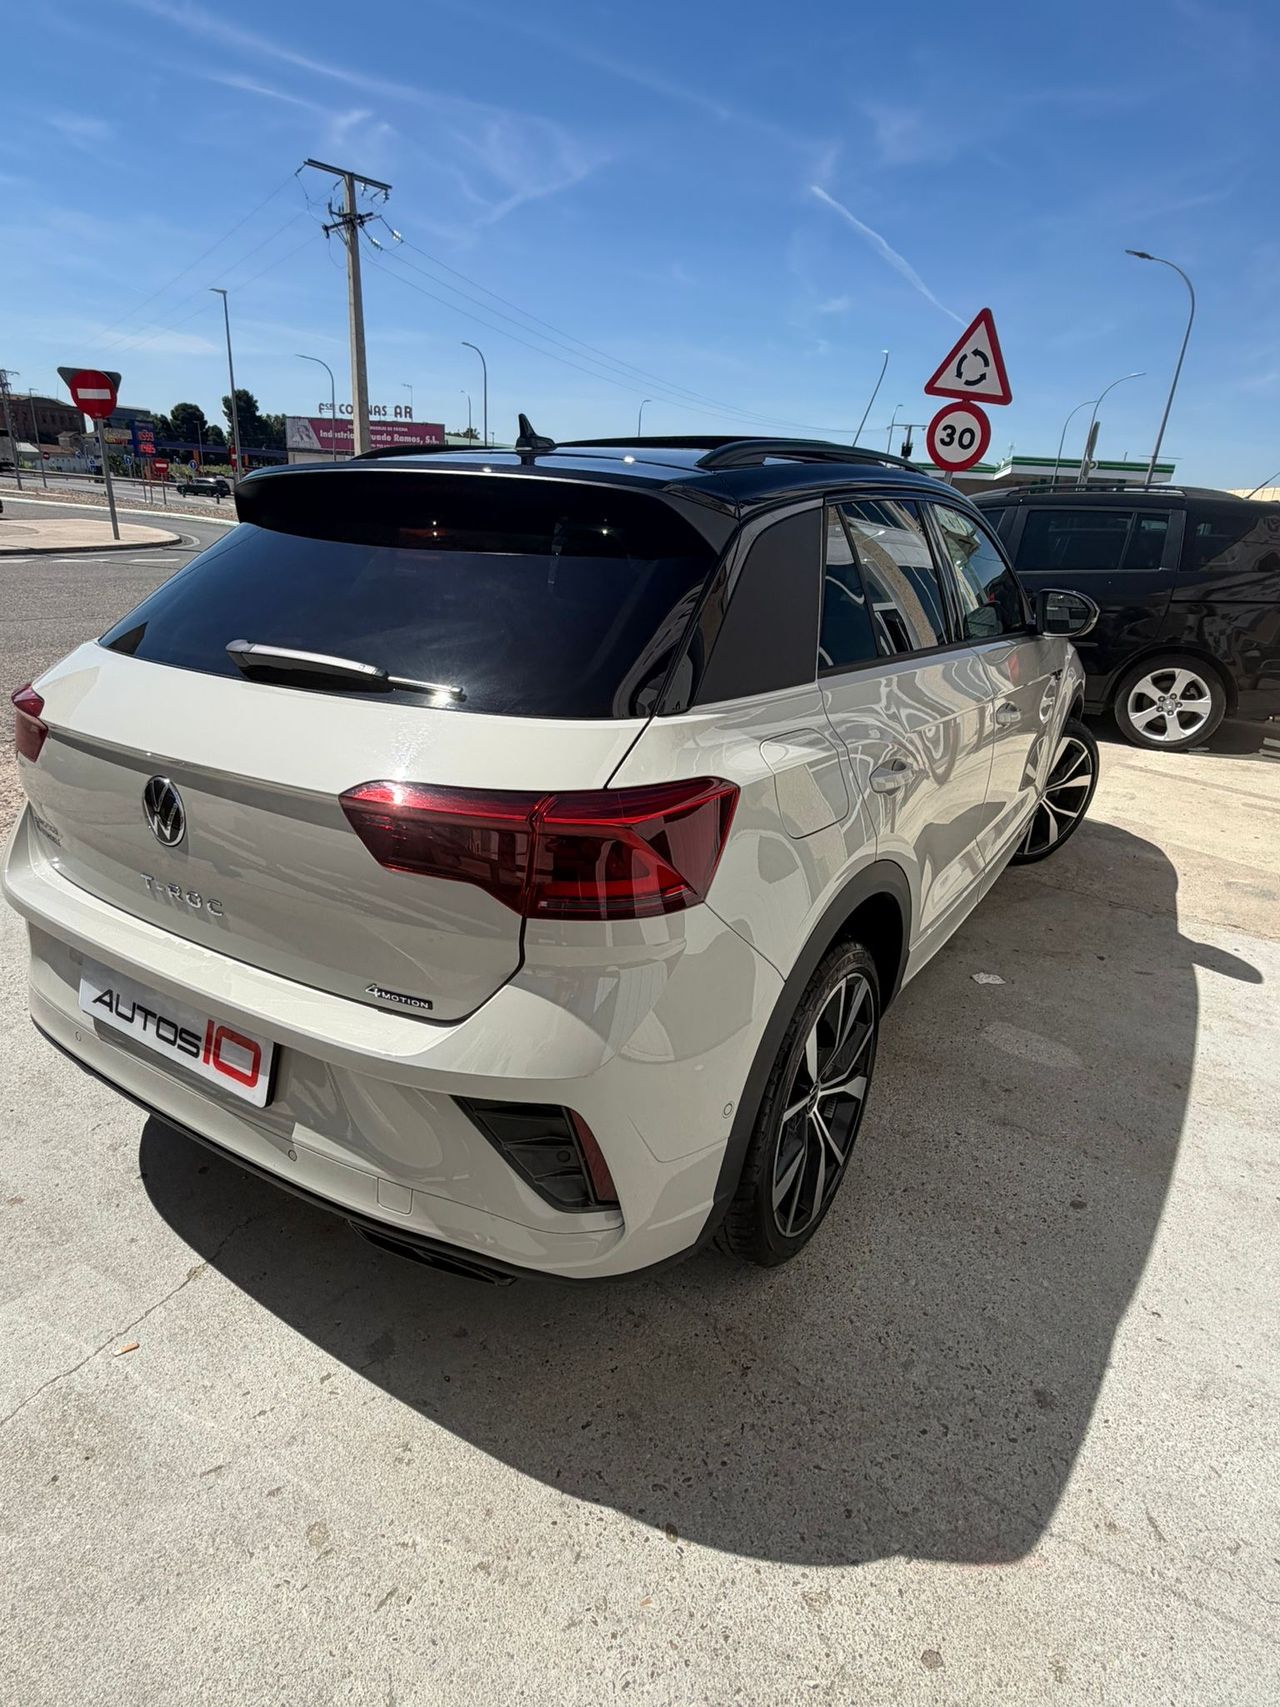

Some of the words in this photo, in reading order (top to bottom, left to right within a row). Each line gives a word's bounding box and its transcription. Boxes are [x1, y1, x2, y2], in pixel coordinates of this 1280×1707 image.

[339, 403, 387, 416] CONAS
[319, 429, 355, 440] Indstria
[370, 432, 392, 442] uado
[393, 433, 423, 445] Ramos,
[939, 424, 976, 450] 30
[140, 873, 225, 917] T-ROC
[364, 983, 430, 1010] 4MOTION
